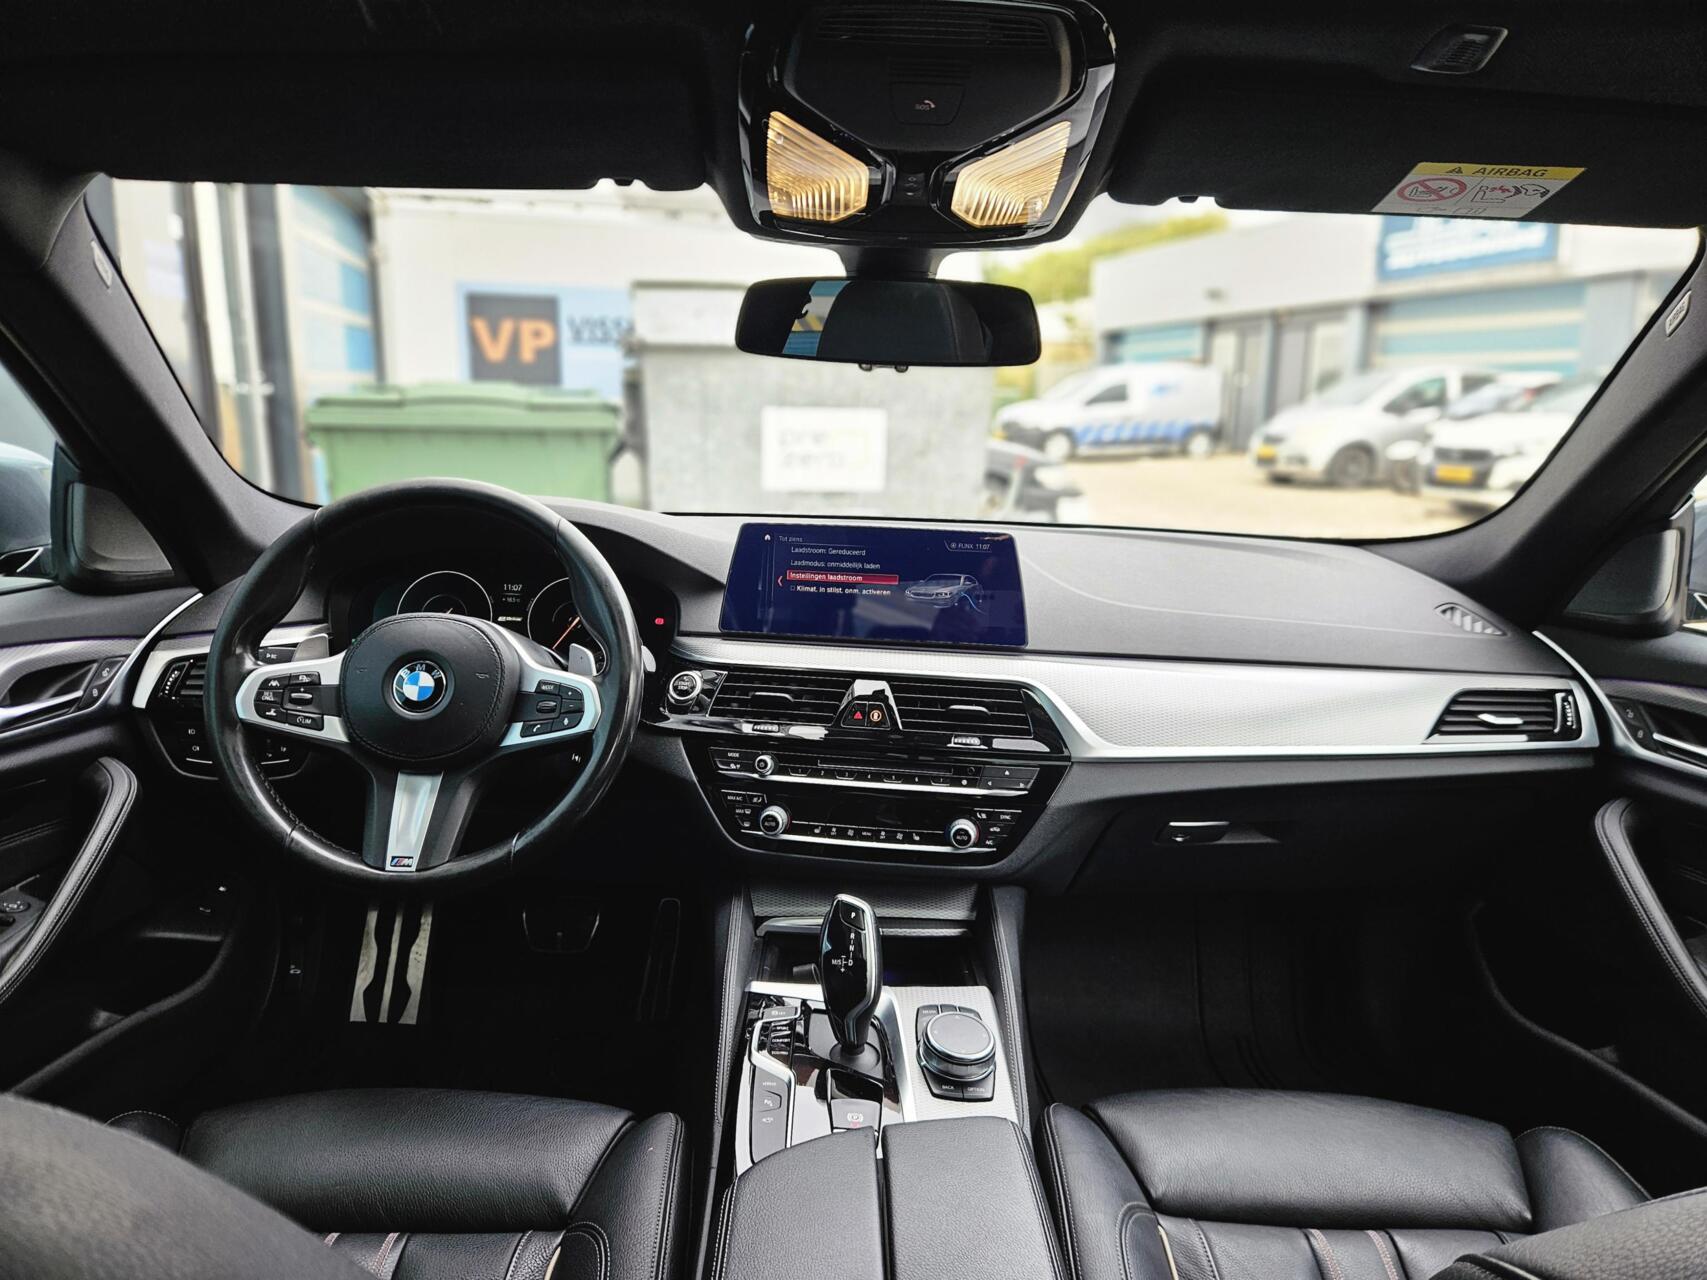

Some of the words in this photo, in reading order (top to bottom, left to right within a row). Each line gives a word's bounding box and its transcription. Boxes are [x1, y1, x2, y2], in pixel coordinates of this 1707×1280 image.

[1472, 167, 1548, 177] AIRBAG
[471, 316, 556, 364] VP
[791, 546, 827, 554] Laadstroom:
[828, 548, 866, 556] Gereduceerd
[790, 559, 826, 567] Laadmodus:
[790, 572, 826, 581] Instellingen
[503, 583, 523, 591] 11:07
[862, 588, 891, 596] activeren
[400, 663, 441, 679] BMW
[850, 911, 856, 919] P
[850, 932, 855, 940] R
[847, 959, 854, 967] D
